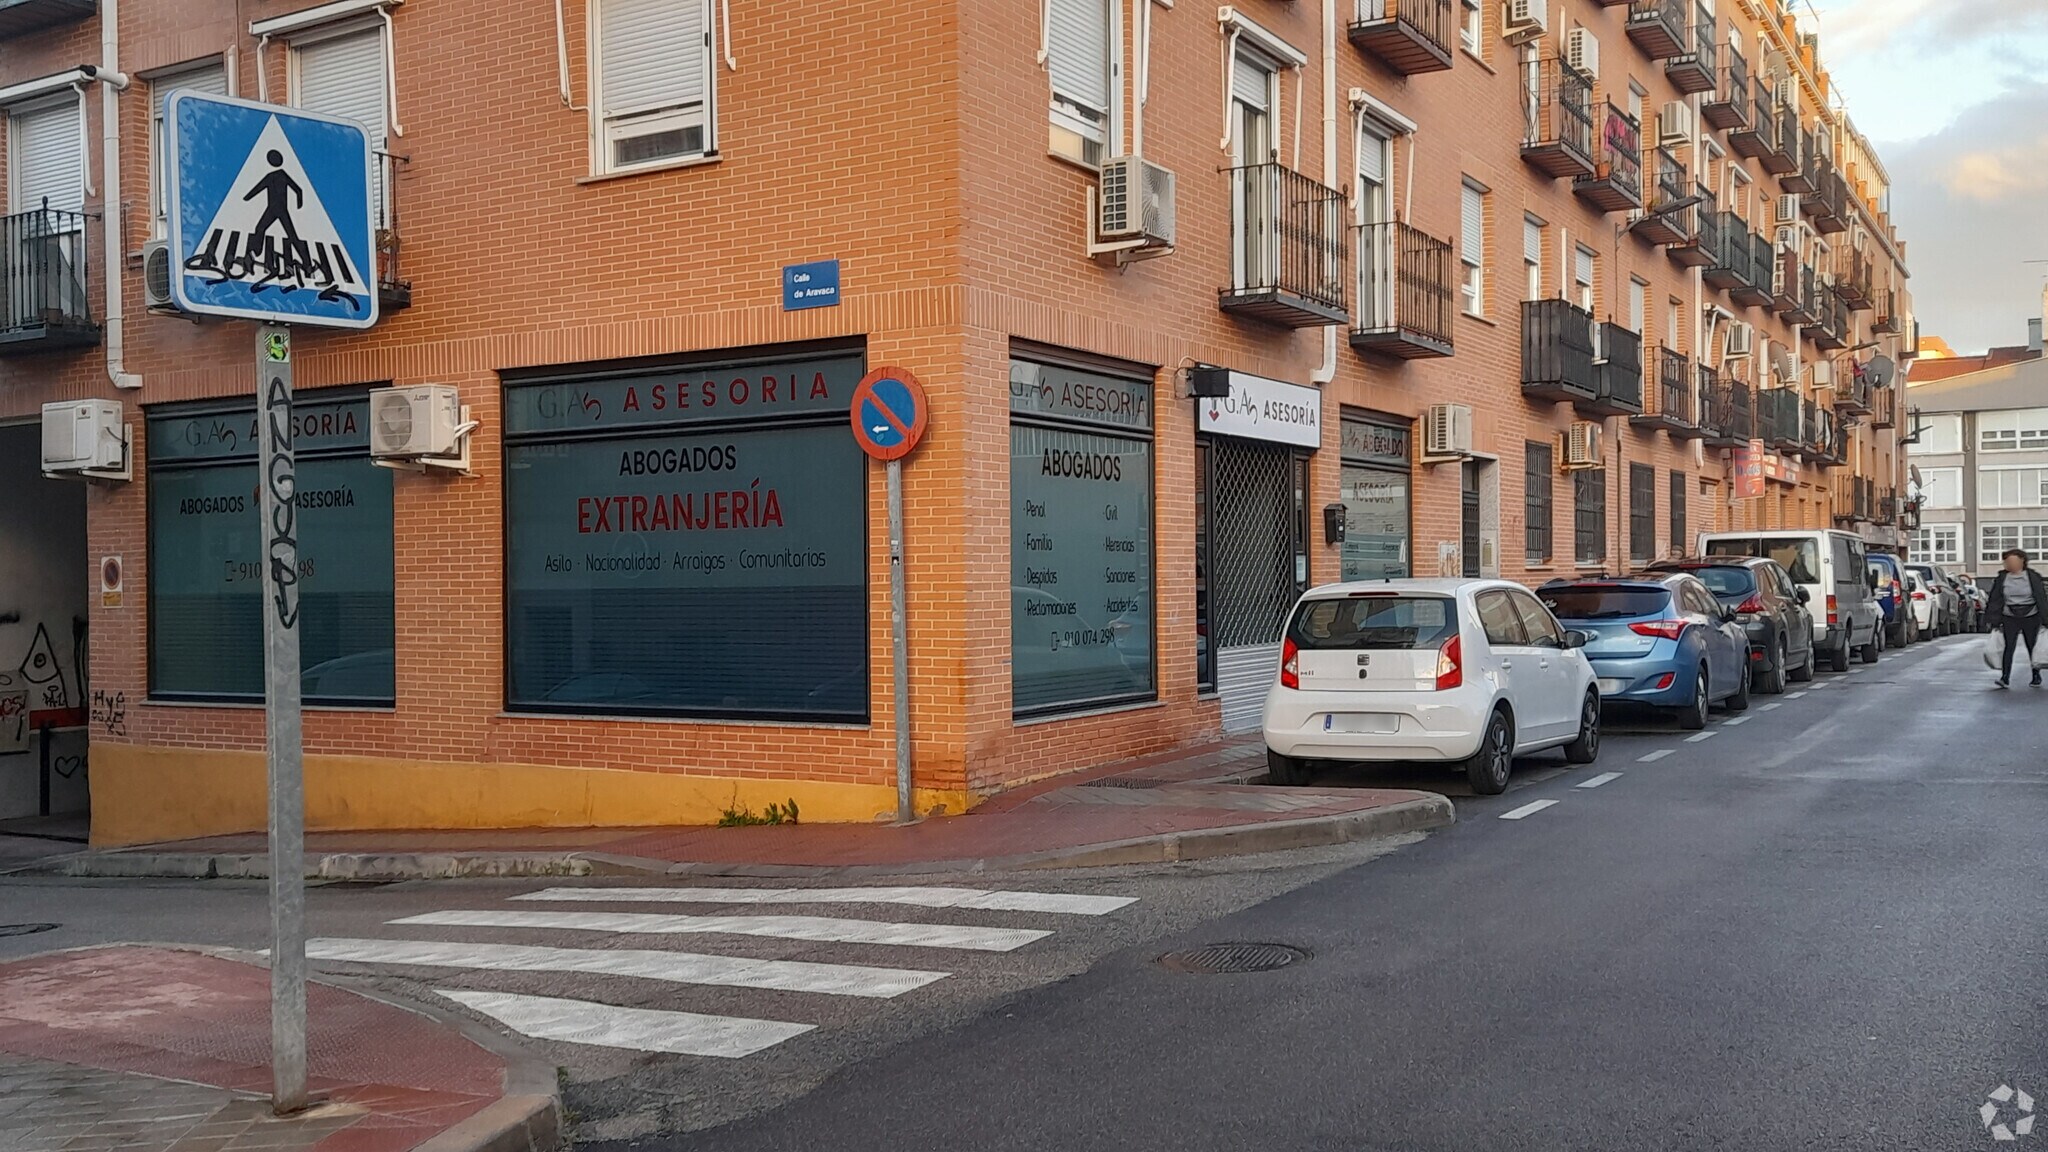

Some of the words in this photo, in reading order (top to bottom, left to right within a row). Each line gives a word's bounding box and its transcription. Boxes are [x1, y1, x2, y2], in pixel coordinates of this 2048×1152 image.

[793, 273, 810, 283] Calle
[793, 290, 804, 299] de
[805, 287, 835, 297] Aravaca
[622, 371, 829, 413] ASESORIA
[1061, 382, 1146, 417] ASESORÍA
[249, 406, 356, 441] ASORÍA
[1263, 400, 1316, 428] ASESORÍA
[619, 445, 737, 477] ABOGADOS
[1041, 447, 1121, 482] ABOGADOS
[179, 495, 245, 516] ABOGADOS
[294, 484, 355, 510] ASESORÍA
[577, 477, 784, 535] EXTRANJERÍA
[1026, 500, 1046, 519] Penal
[1026, 533, 1053, 551] Familia
[1105, 536, 1135, 553] Herencias
[239, 562, 262, 582] 910
[299, 558, 315, 579] 98
[545, 554, 572, 573] Asilo
[585, 552, 661, 572] Nacionalidad
[672, 551, 726, 575] Arraigos
[739, 547, 826, 569] Comunitarios
[1026, 567, 1058, 587] Despidos
[1105, 567, 1136, 583] Sanciones
[1026, 599, 1077, 617] Reclamaciones
[1064, 631, 1081, 648] 910
[1082, 629, 1098, 646] 074
[1100, 626, 1116, 644] 298
